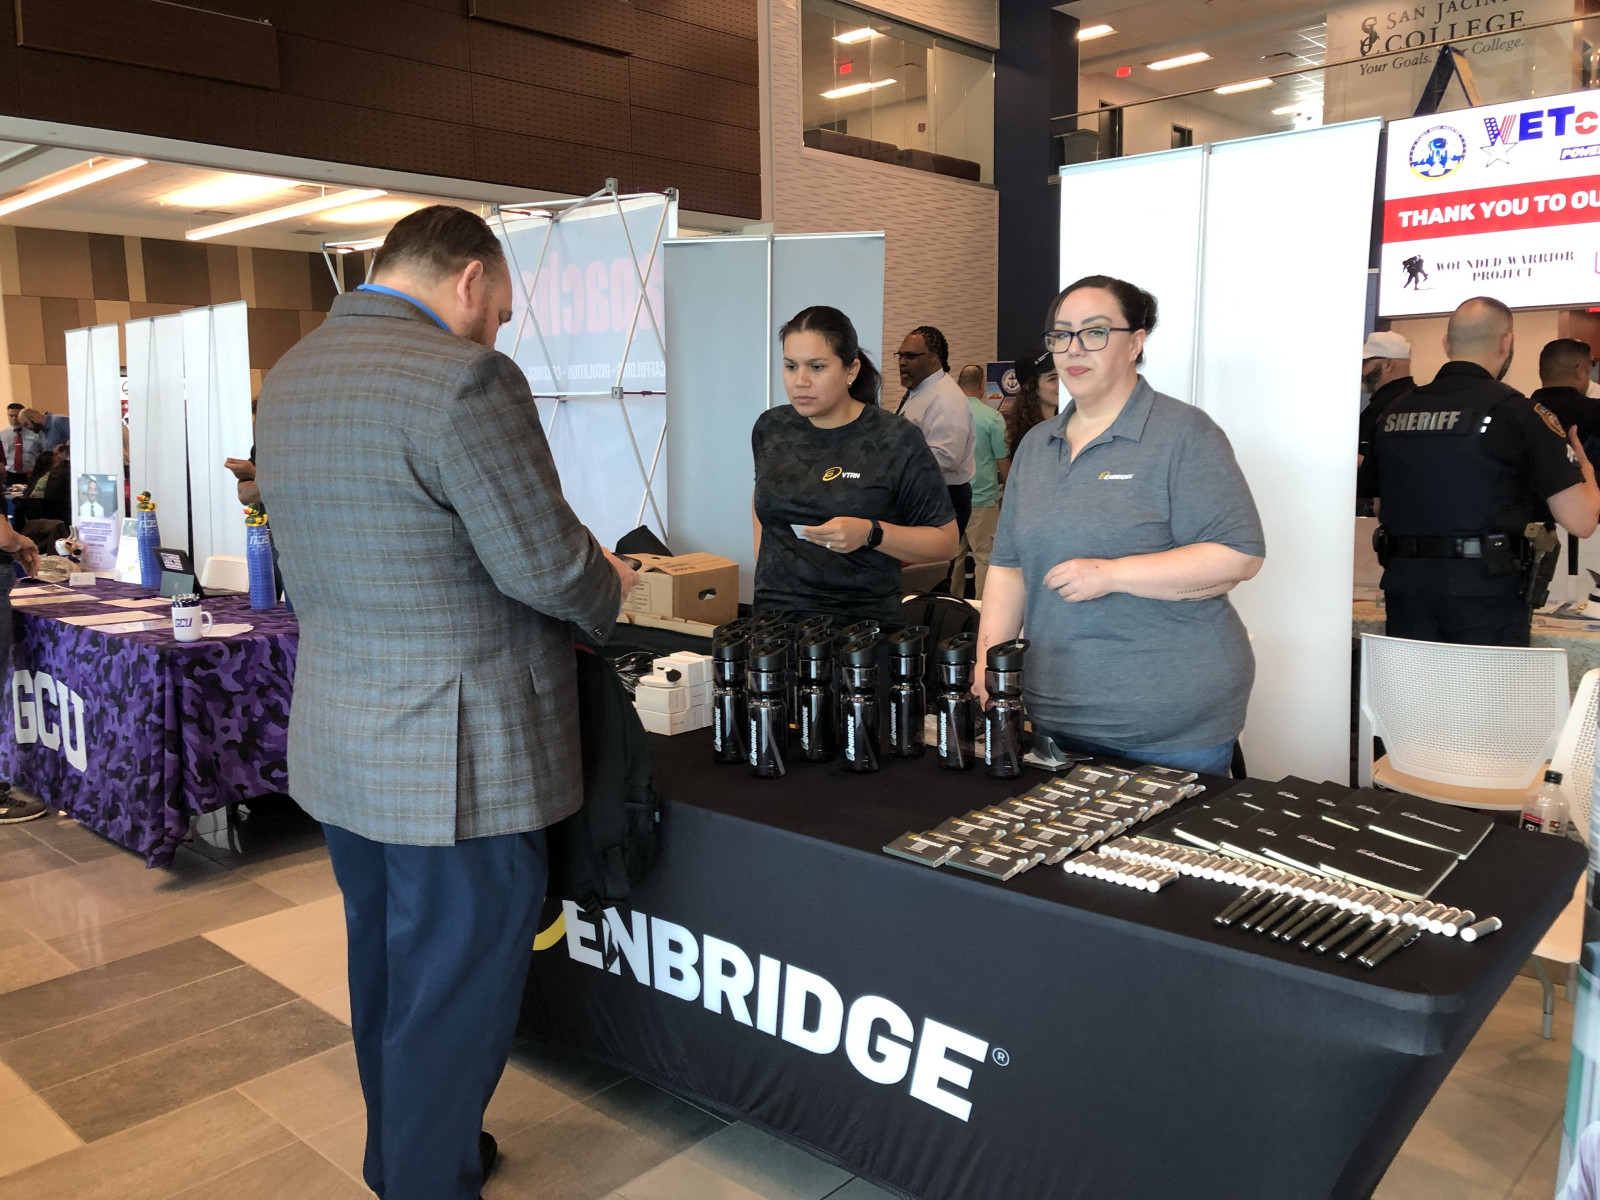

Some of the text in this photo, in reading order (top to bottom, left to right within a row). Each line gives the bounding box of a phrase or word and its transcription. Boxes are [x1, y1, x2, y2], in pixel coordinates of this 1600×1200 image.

[1386, 6, 1426, 29] SAN
[1385, 10, 1525, 54] COLLEGE
[1360, 62, 1389, 76] Your
[1392, 52, 1432, 69] Goals.
[1472, 37, 1525, 56] College.
[1398, 203, 1476, 228] THANK
[1480, 197, 1529, 219] YOU
[1534, 193, 1567, 213] TO
[1436, 251, 1574, 271] WOUNDED WARRIOR
[1473, 267, 1532, 281] PROJECT
[1384, 410, 1462, 433] SHERIFF
[842, 471, 861, 479] VTRN
[12, 669, 88, 773] GCU
